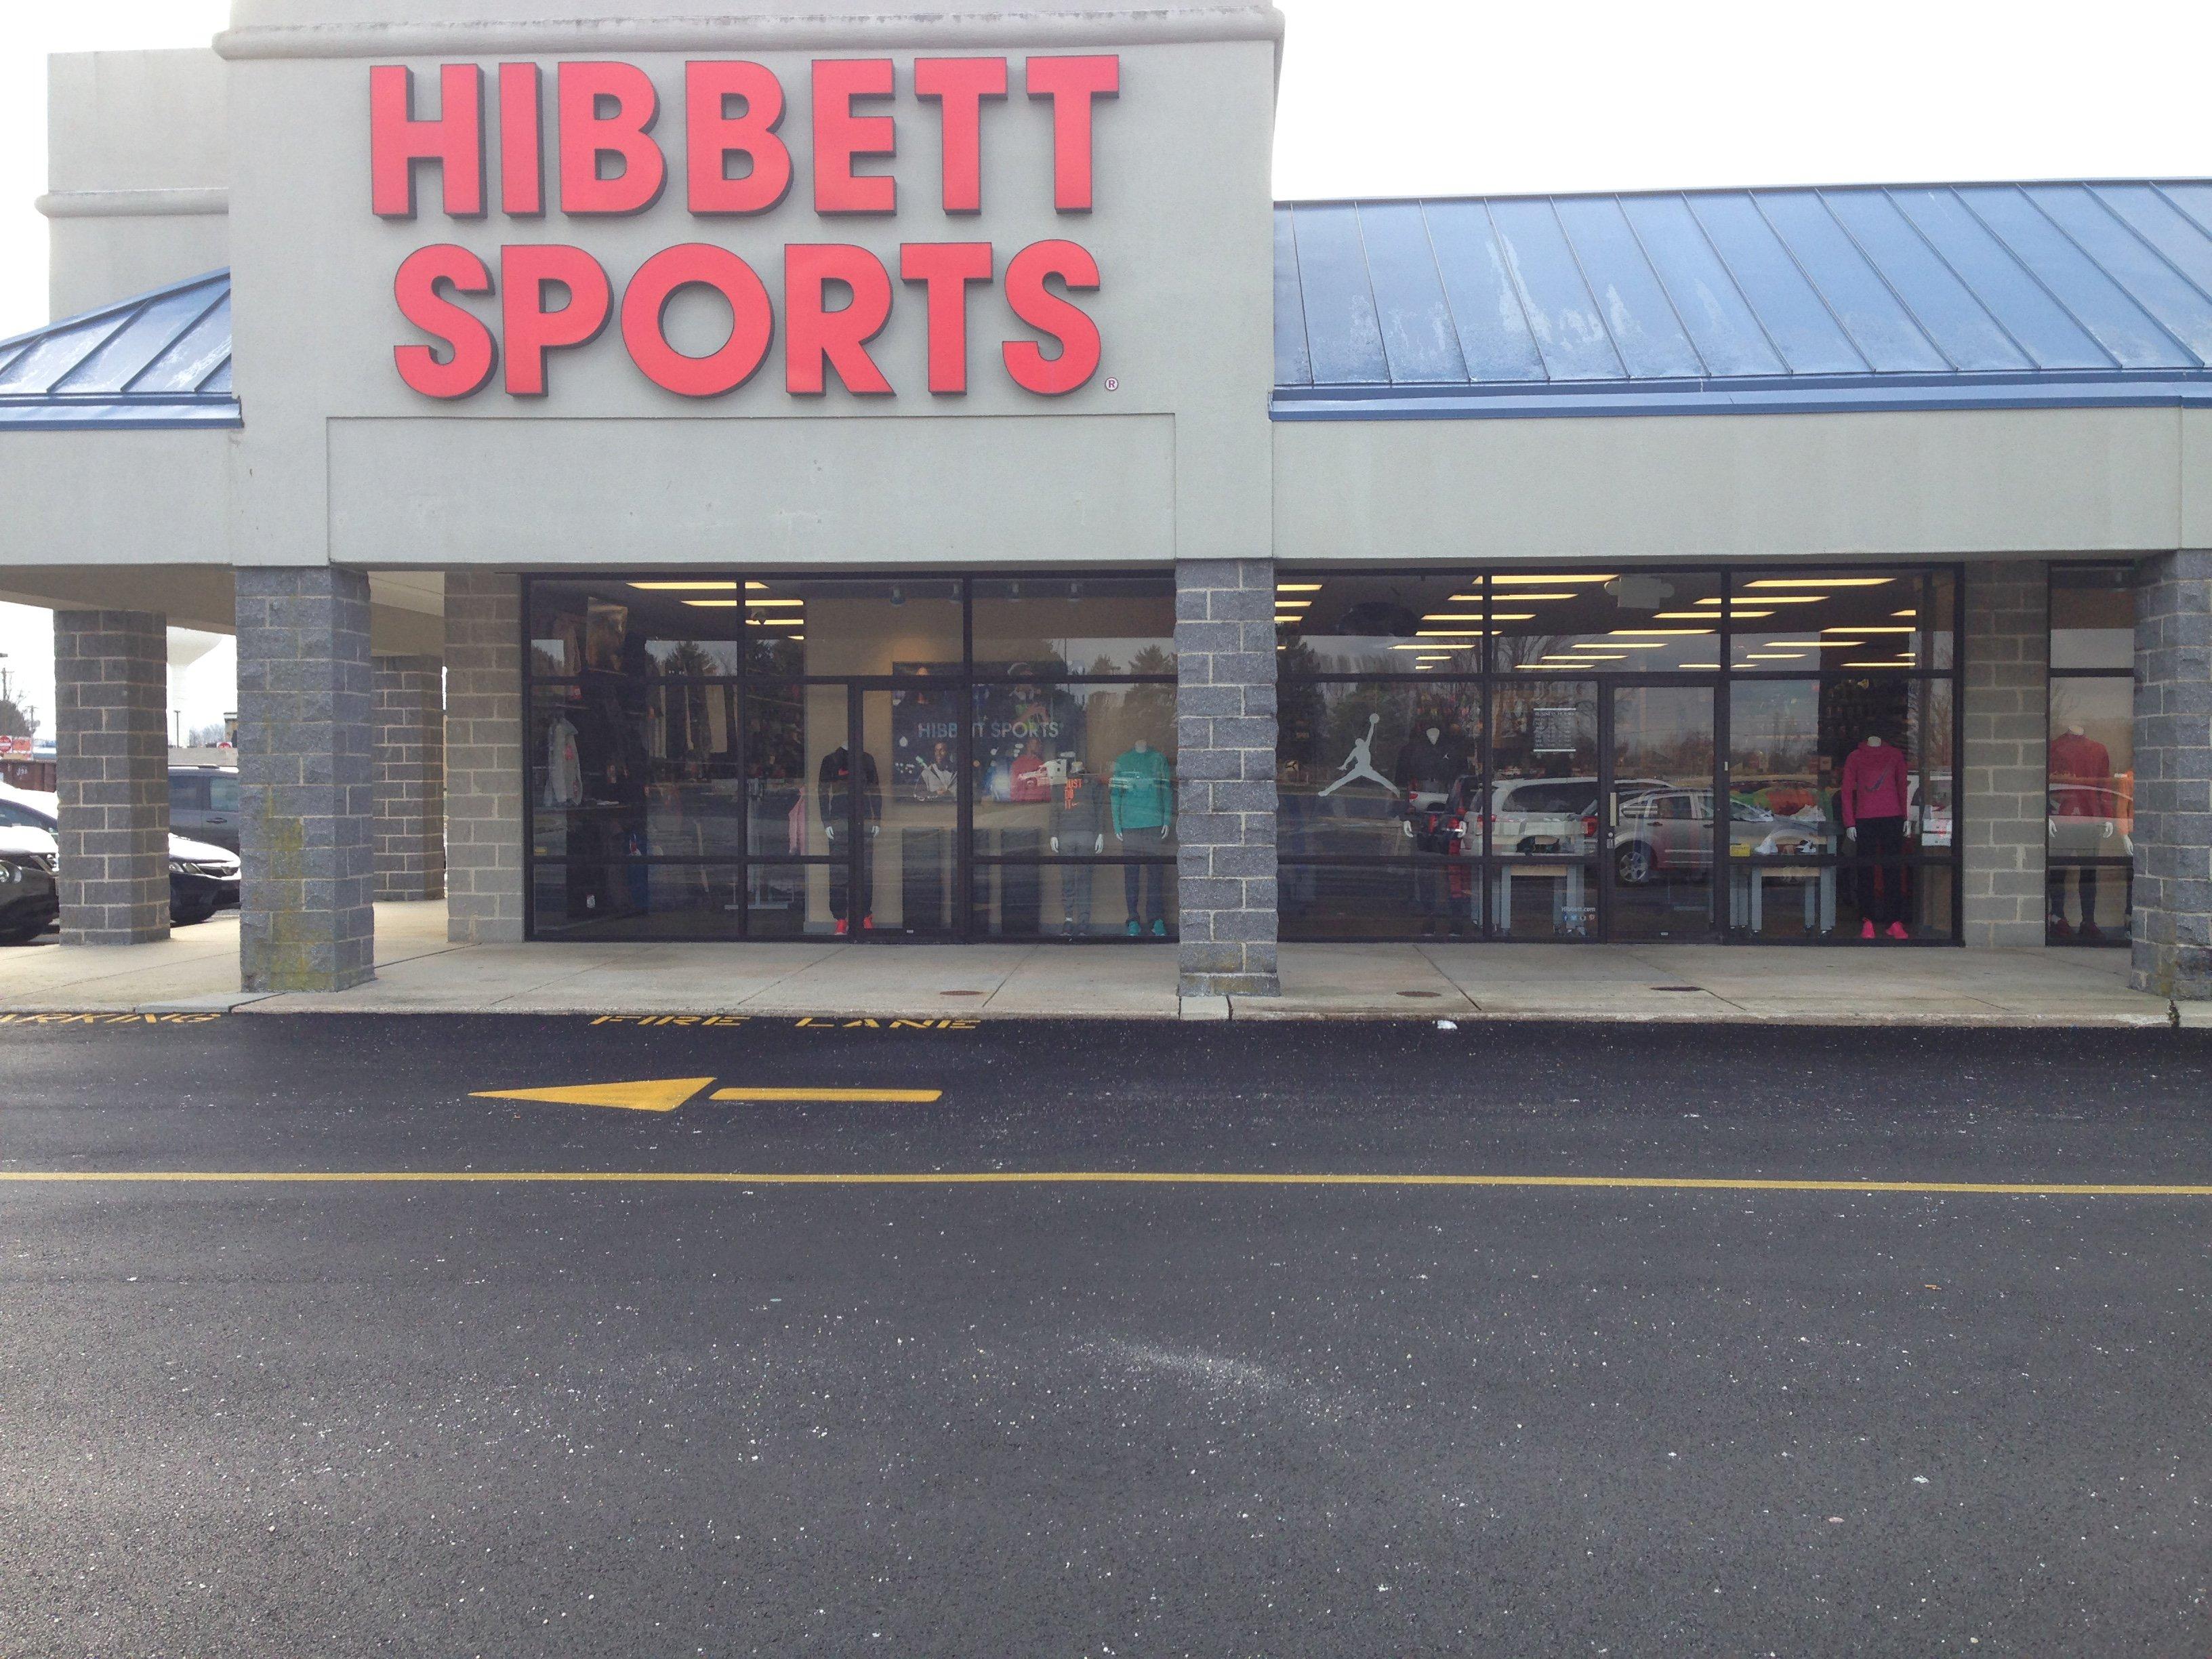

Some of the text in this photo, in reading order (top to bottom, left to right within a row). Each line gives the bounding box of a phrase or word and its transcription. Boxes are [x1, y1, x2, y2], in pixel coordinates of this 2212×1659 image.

[370, 55, 1120, 218] HIBBETT
[393, 239, 1101, 398] SPORTS
[918, 721, 1059, 738] HIBBTT SPORTS
[1065, 779, 1082, 789] JUST
[589, 1015, 982, 1029] FIRE LANE
